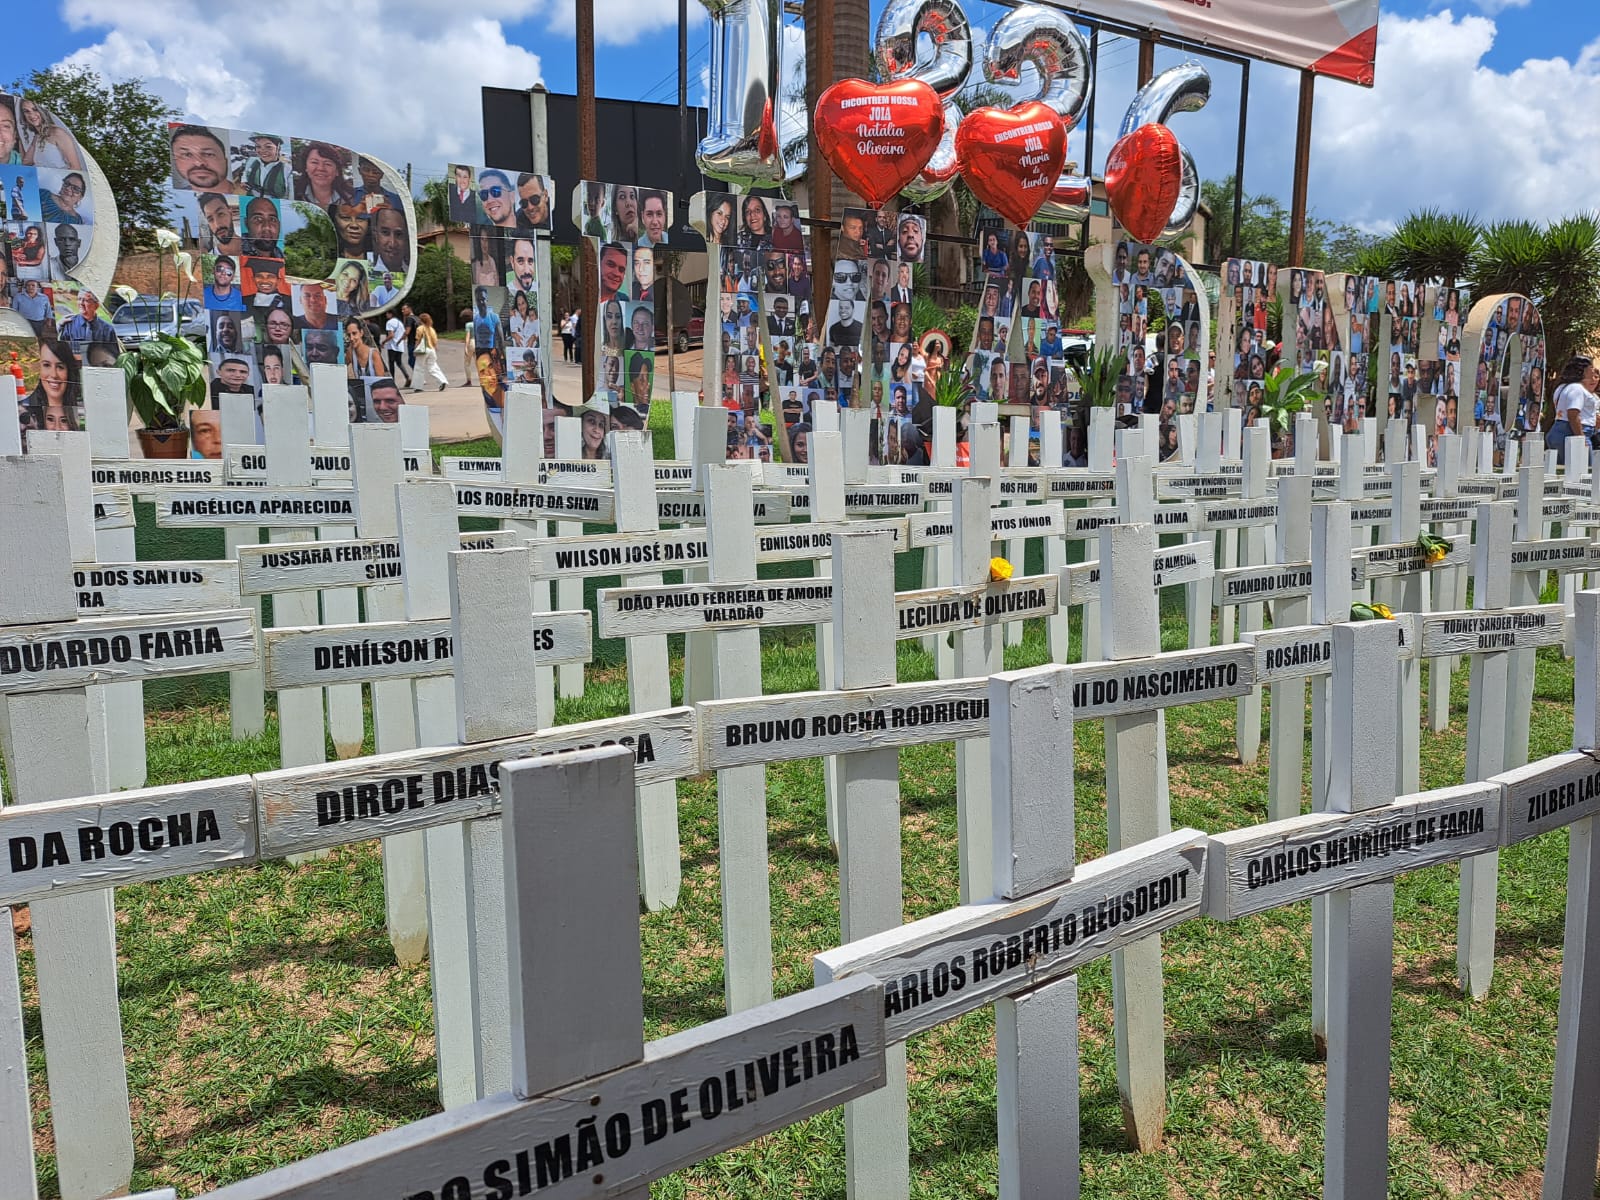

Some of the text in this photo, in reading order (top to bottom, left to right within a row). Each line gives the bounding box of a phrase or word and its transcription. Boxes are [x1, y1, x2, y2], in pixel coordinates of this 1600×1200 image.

[841, 95, 918, 109] ENCONTREM NOSSA
[856, 123, 905, 137] Natália
[994, 124, 1034, 143] ENCONTREM
[856, 140, 906, 155] Oliveira
[1018, 153, 1050, 168] Maria
[119, 470, 173, 483] MORAIS
[177, 470, 212, 483] ELIAS
[1051, 480, 1114, 492] ELIANDRO BATISTA
[1017, 482, 1038, 494] FILHO
[171, 498, 353, 515] ANGÉLICA APARECIDA
[485, 490, 544, 509] ROBERTO
[547, 496, 564, 509] DA
[567, 496, 599, 512] SILVA
[875, 493, 919, 506] TALIBERTI
[1018, 515, 1051, 529] JÚNIOR
[1165, 511, 1188, 524] LIMA
[1207, 506, 1274, 522] AMARINA DE LOURDES
[760, 533, 832, 551] EDNILSON DOS
[261, 547, 332, 568] JUSSARA
[555, 547, 622, 569] WILSON
[624, 541, 661, 563] JOSÉ
[664, 543, 685, 560] DA
[1369, 549, 1394, 562] CAMILA
[1530, 549, 1548, 562] LUIZ
[1549, 548, 1561, 559] DA
[1562, 547, 1585, 558] SILVA
[1398, 561, 1407, 572] DA
[91, 570, 129, 587] DOS
[133, 567, 203, 585] SANTOS
[1228, 576, 1275, 596] EVANDRO
[1276, 572, 1297, 590] LUIZ
[617, 593, 652, 612] JOÃO
[656, 592, 700, 609] PAULO
[703, 588, 765, 605] FERREIRA
[767, 587, 783, 602] DE
[963, 599, 983, 619] DE
[985, 588, 1047, 616] OLIVEIRA
[703, 605, 764, 623] VALADÃO
[1444, 618, 1479, 634] RODNEY
[1513, 613, 1546, 630] PAULINO
[138, 626, 225, 660] FARIA
[314, 638, 428, 671] DENÍLSON
[1266, 642, 1321, 670] ROSÁRIA
[1092, 678, 1118, 706] DO
[1123, 662, 1238, 702] NASCIMENTO
[726, 717, 806, 747] BRUNO
[812, 709, 887, 738] ROCHA
[316, 774, 425, 827] DIRCE
[1527, 782, 1576, 823] ZILBER
[8, 809, 221, 873] DA ROCHA
[1247, 807, 1485, 890] CARLOS HENRIQUE DE FARIA
[972, 913, 1077, 984] ROBERTO
[1082, 869, 1190, 938] DEUSDEDIT
[483, 1112, 632, 1200] SIMÃO
[640, 1087, 691, 1147] DE
[699, 1023, 860, 1122] OLIVEIRA
